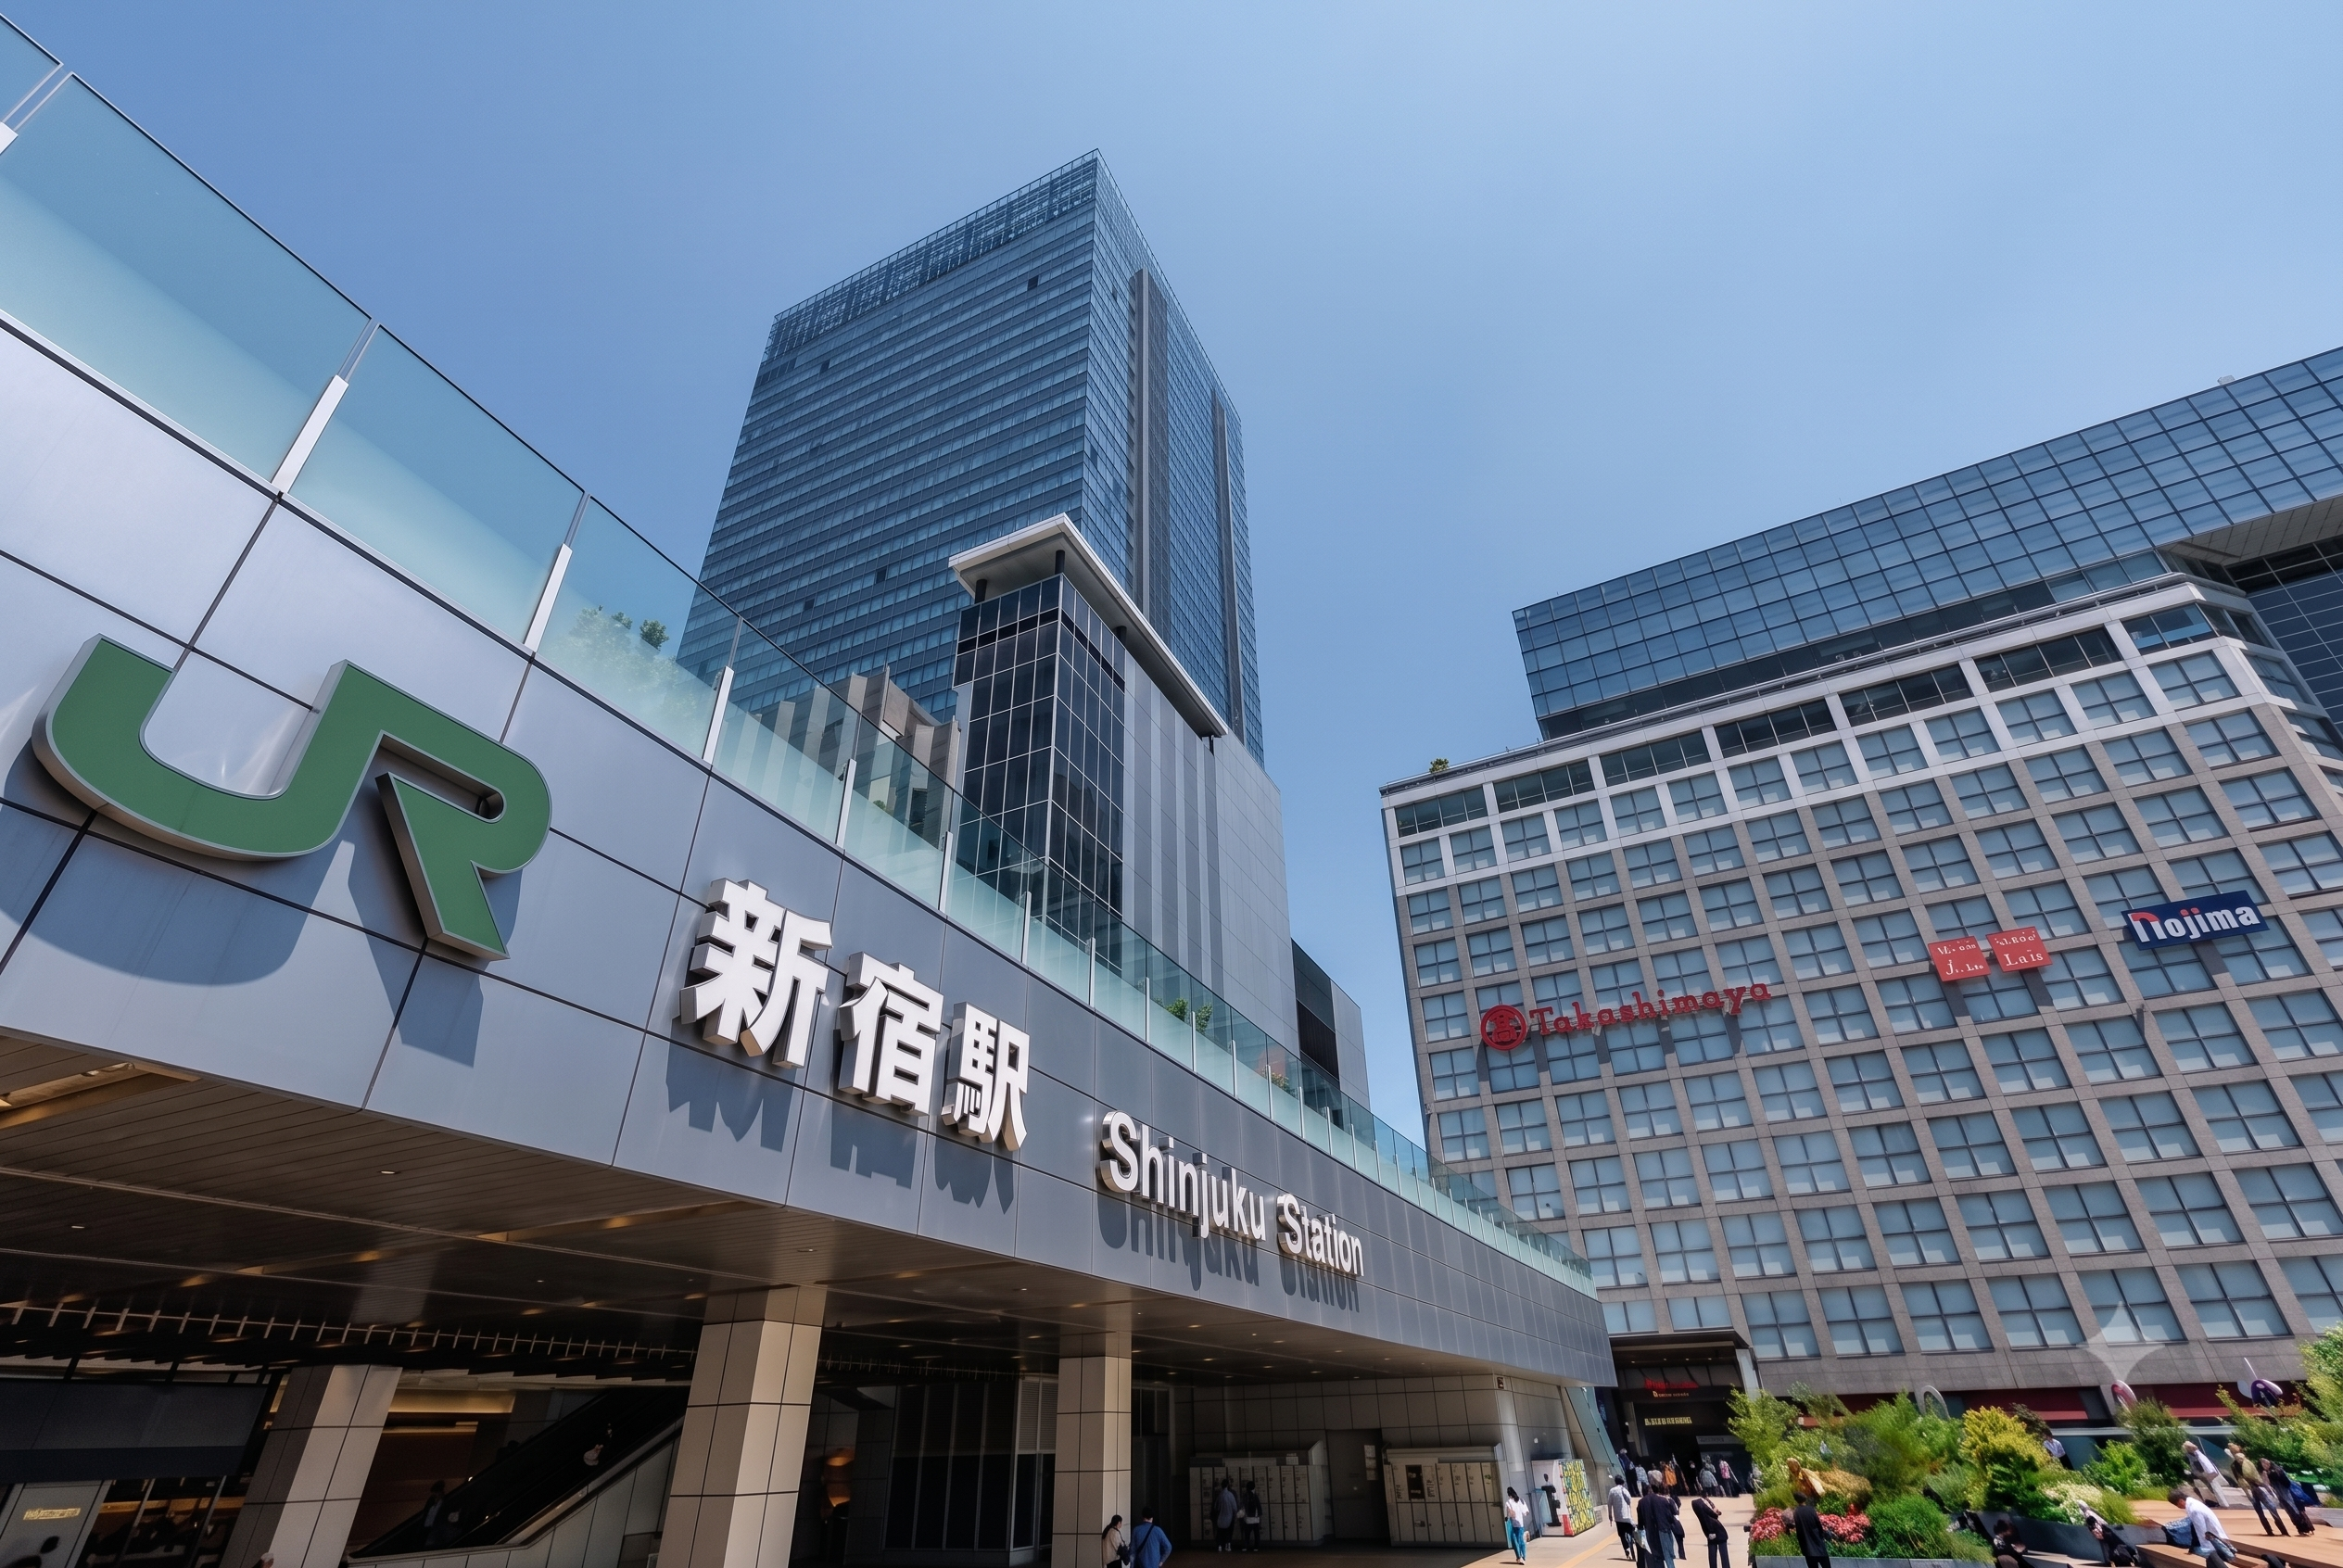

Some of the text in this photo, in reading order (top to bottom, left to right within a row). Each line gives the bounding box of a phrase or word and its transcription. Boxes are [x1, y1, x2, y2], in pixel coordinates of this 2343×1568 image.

[32, 633, 553, 959] JR
[679, 878, 1030, 1151] 新宿駅
[1529, 982, 1772, 1036] Takashimaya
[1097, 1110, 1364, 1277] Shinjuku Station
